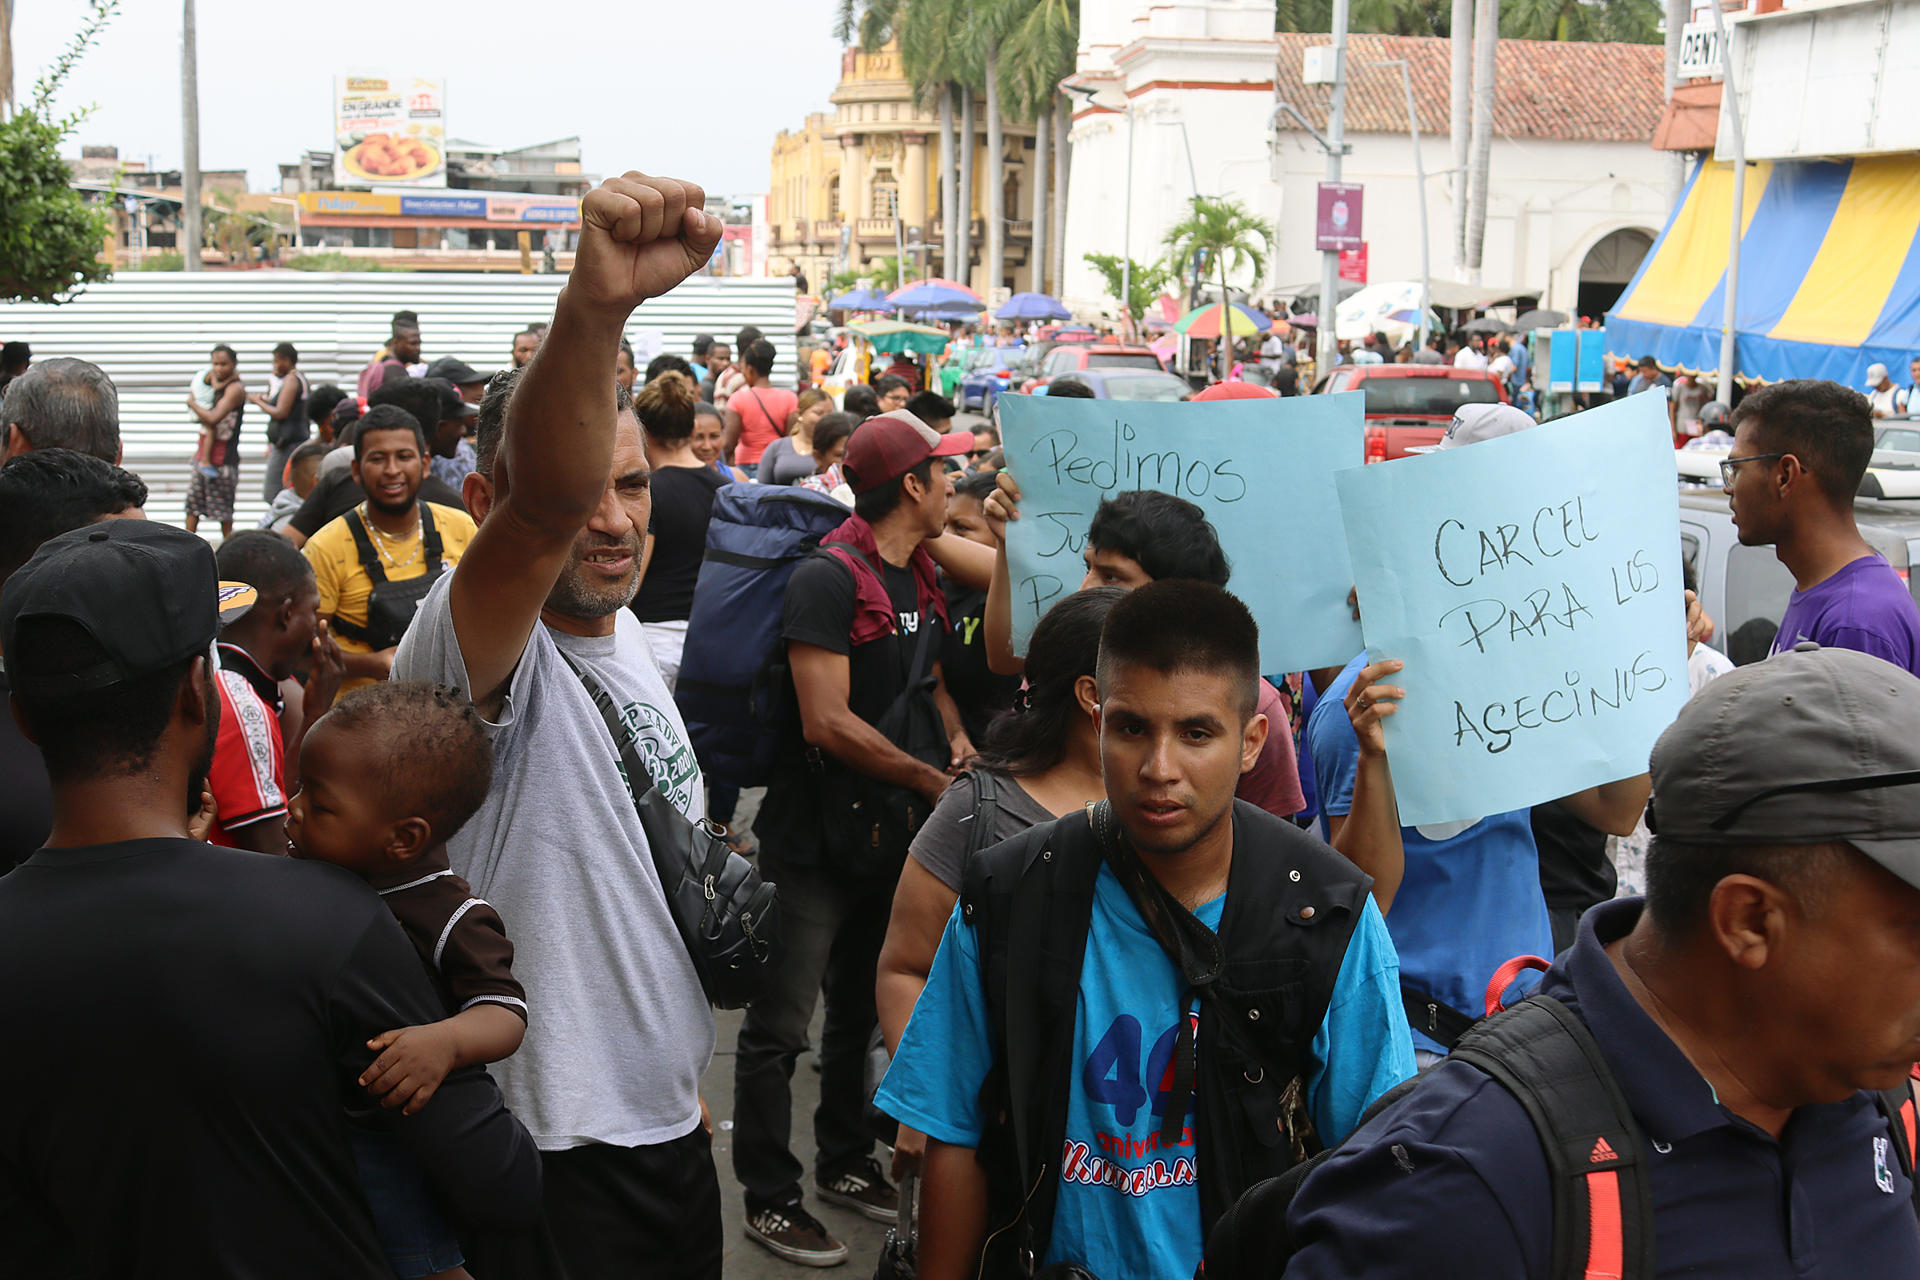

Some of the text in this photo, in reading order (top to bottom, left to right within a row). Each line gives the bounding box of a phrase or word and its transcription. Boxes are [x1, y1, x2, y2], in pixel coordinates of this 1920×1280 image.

[1031, 419, 1246, 502] Pedimos
[1037, 512, 1090, 557] Ju
[1435, 496, 1599, 587] CARCEL
[1439, 549, 1658, 653] PARA LOS
[671, 751, 691, 781] 2020
